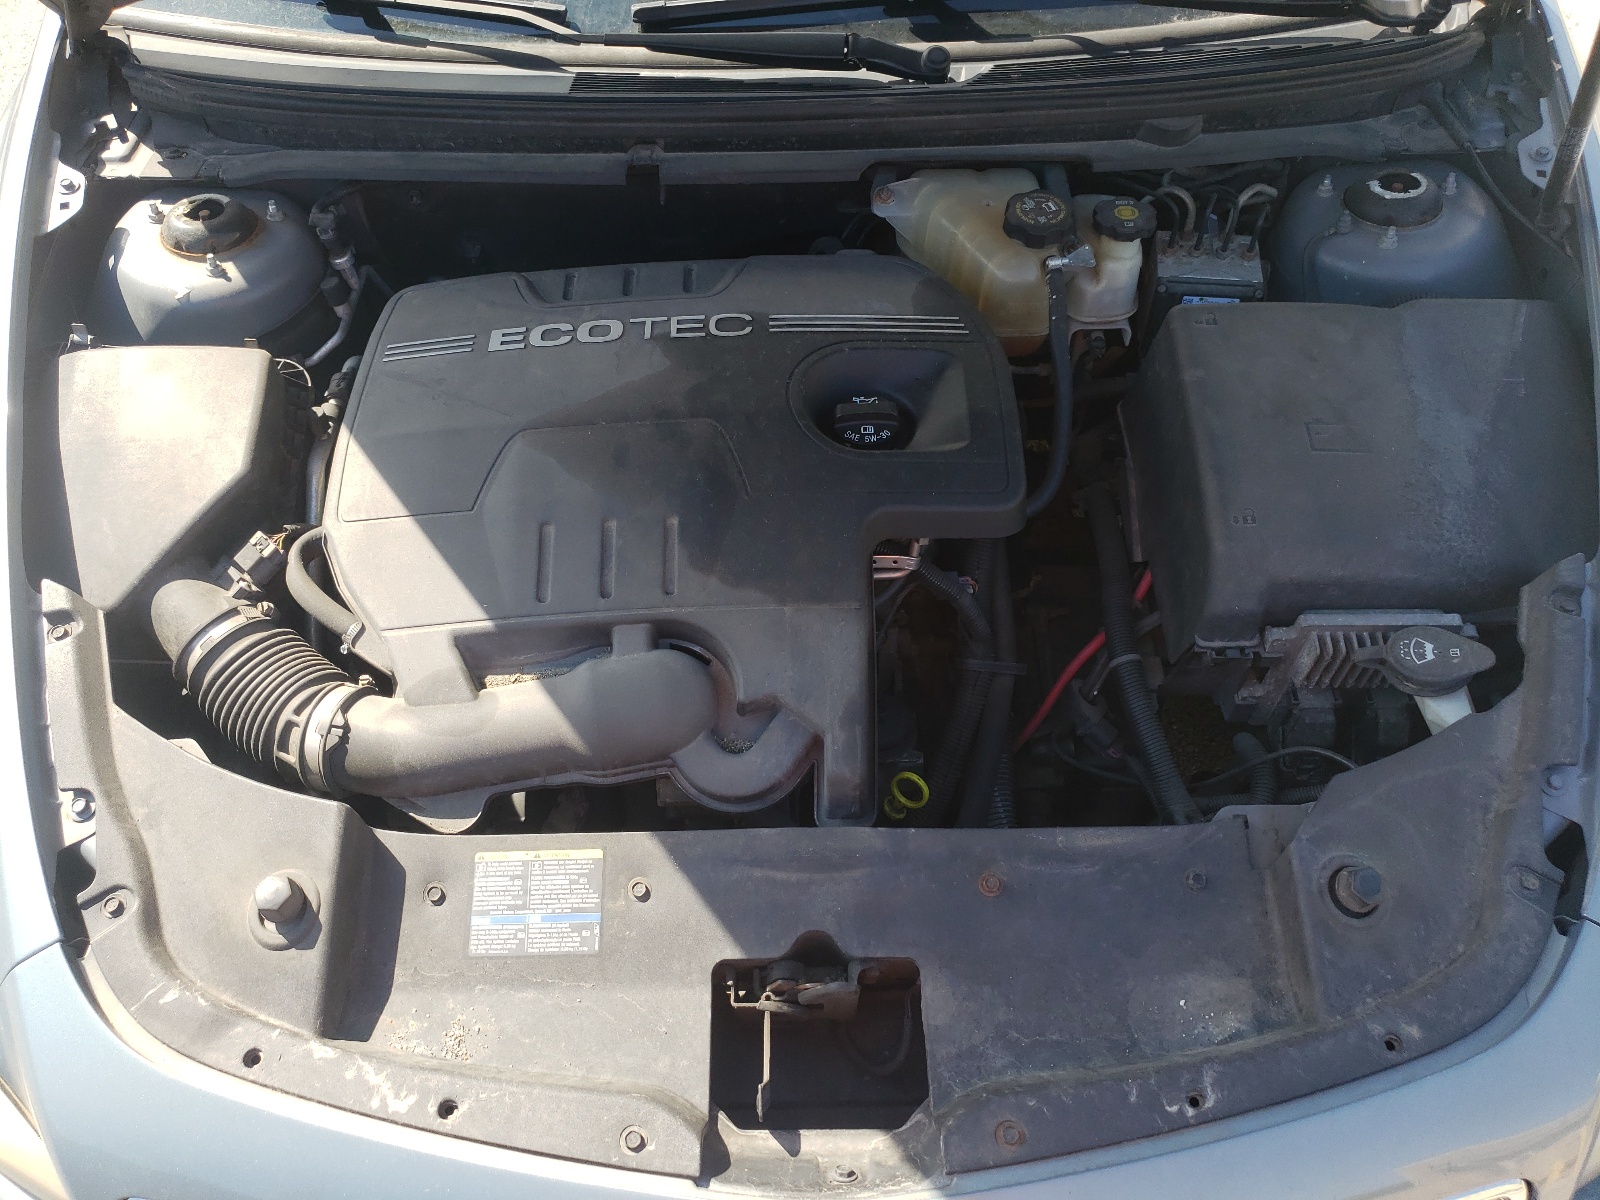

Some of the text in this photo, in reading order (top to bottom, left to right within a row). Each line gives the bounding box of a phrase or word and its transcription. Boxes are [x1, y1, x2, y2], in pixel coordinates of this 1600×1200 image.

[487, 313, 753, 352] ECOTEC
[844, 431, 891, 442] SAE 5W-30
